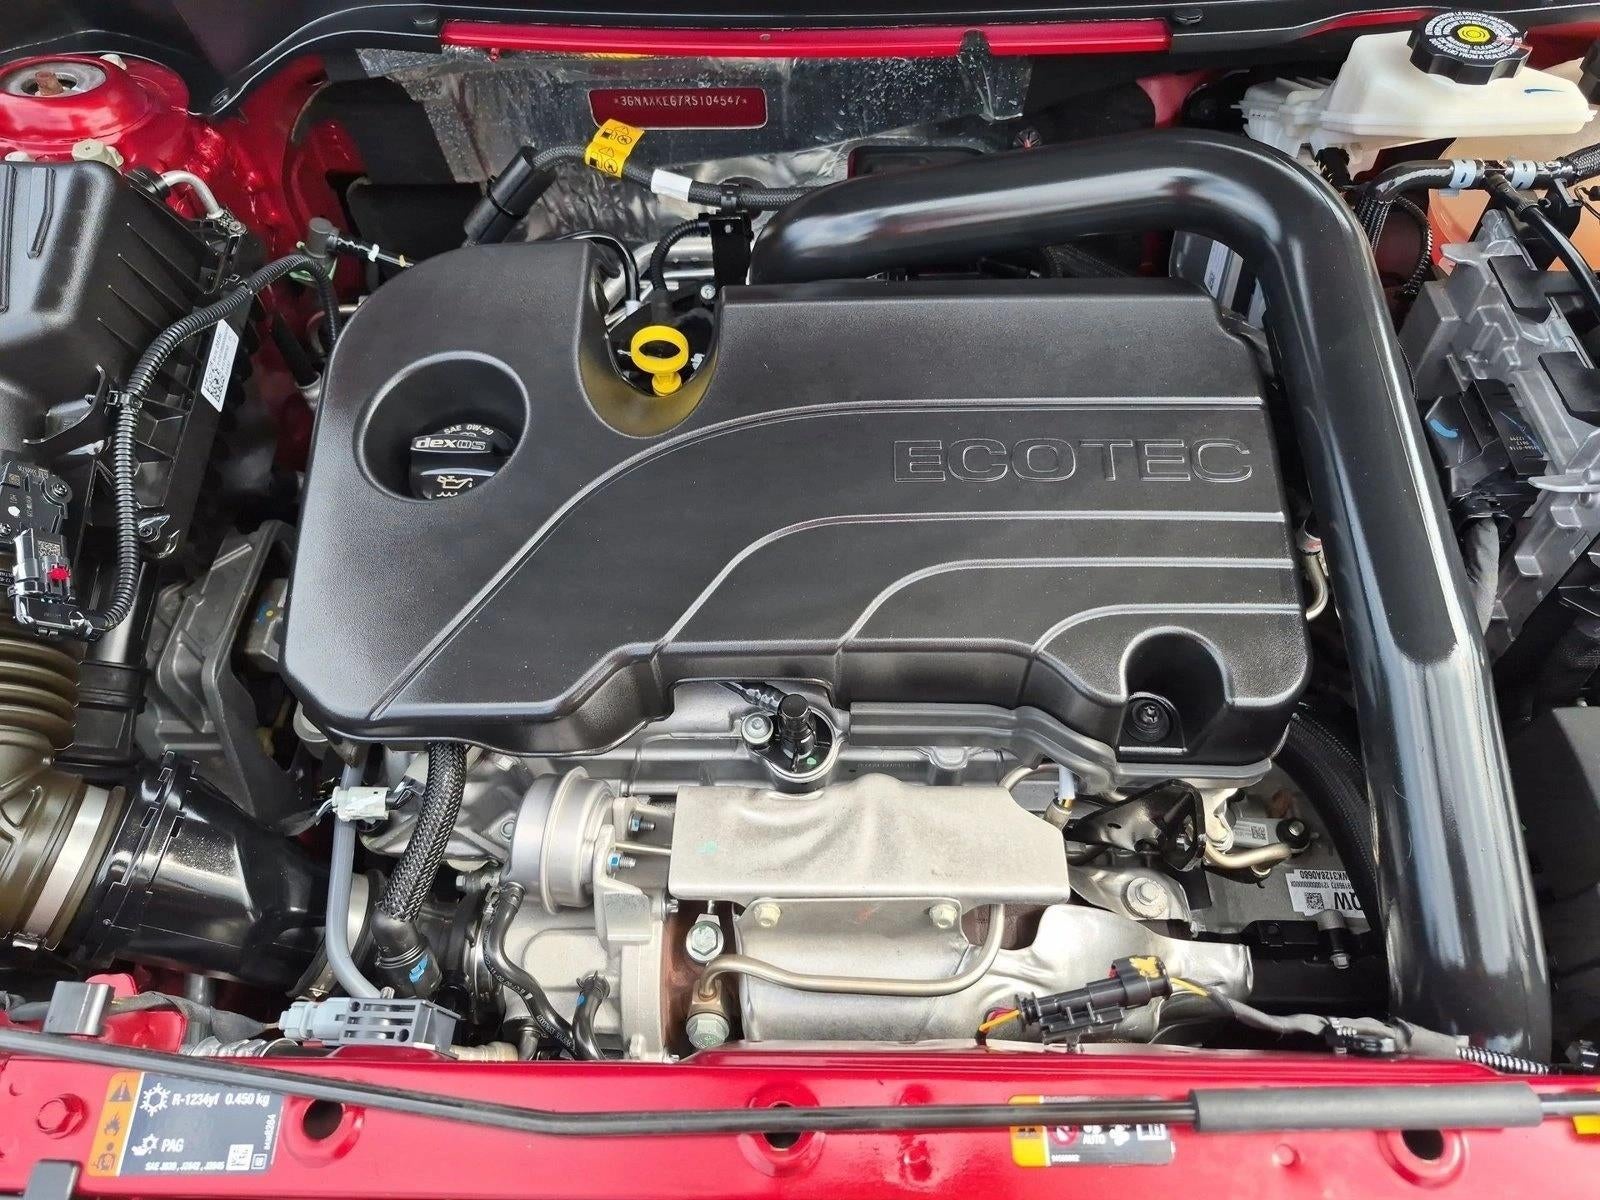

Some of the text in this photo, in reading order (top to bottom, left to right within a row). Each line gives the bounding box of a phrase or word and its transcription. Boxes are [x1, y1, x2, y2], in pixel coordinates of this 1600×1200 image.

[443, 423, 494, 436] SAE 0W-20
[415, 437, 487, 451] dexos
[893, 438, 1252, 483] ECOTEC
[172, 1093, 271, 1108] R-1234yf 0.450 kg
[160, 1138, 185, 1152] PAG
[1082, 1134, 1106, 1145] AUTO
